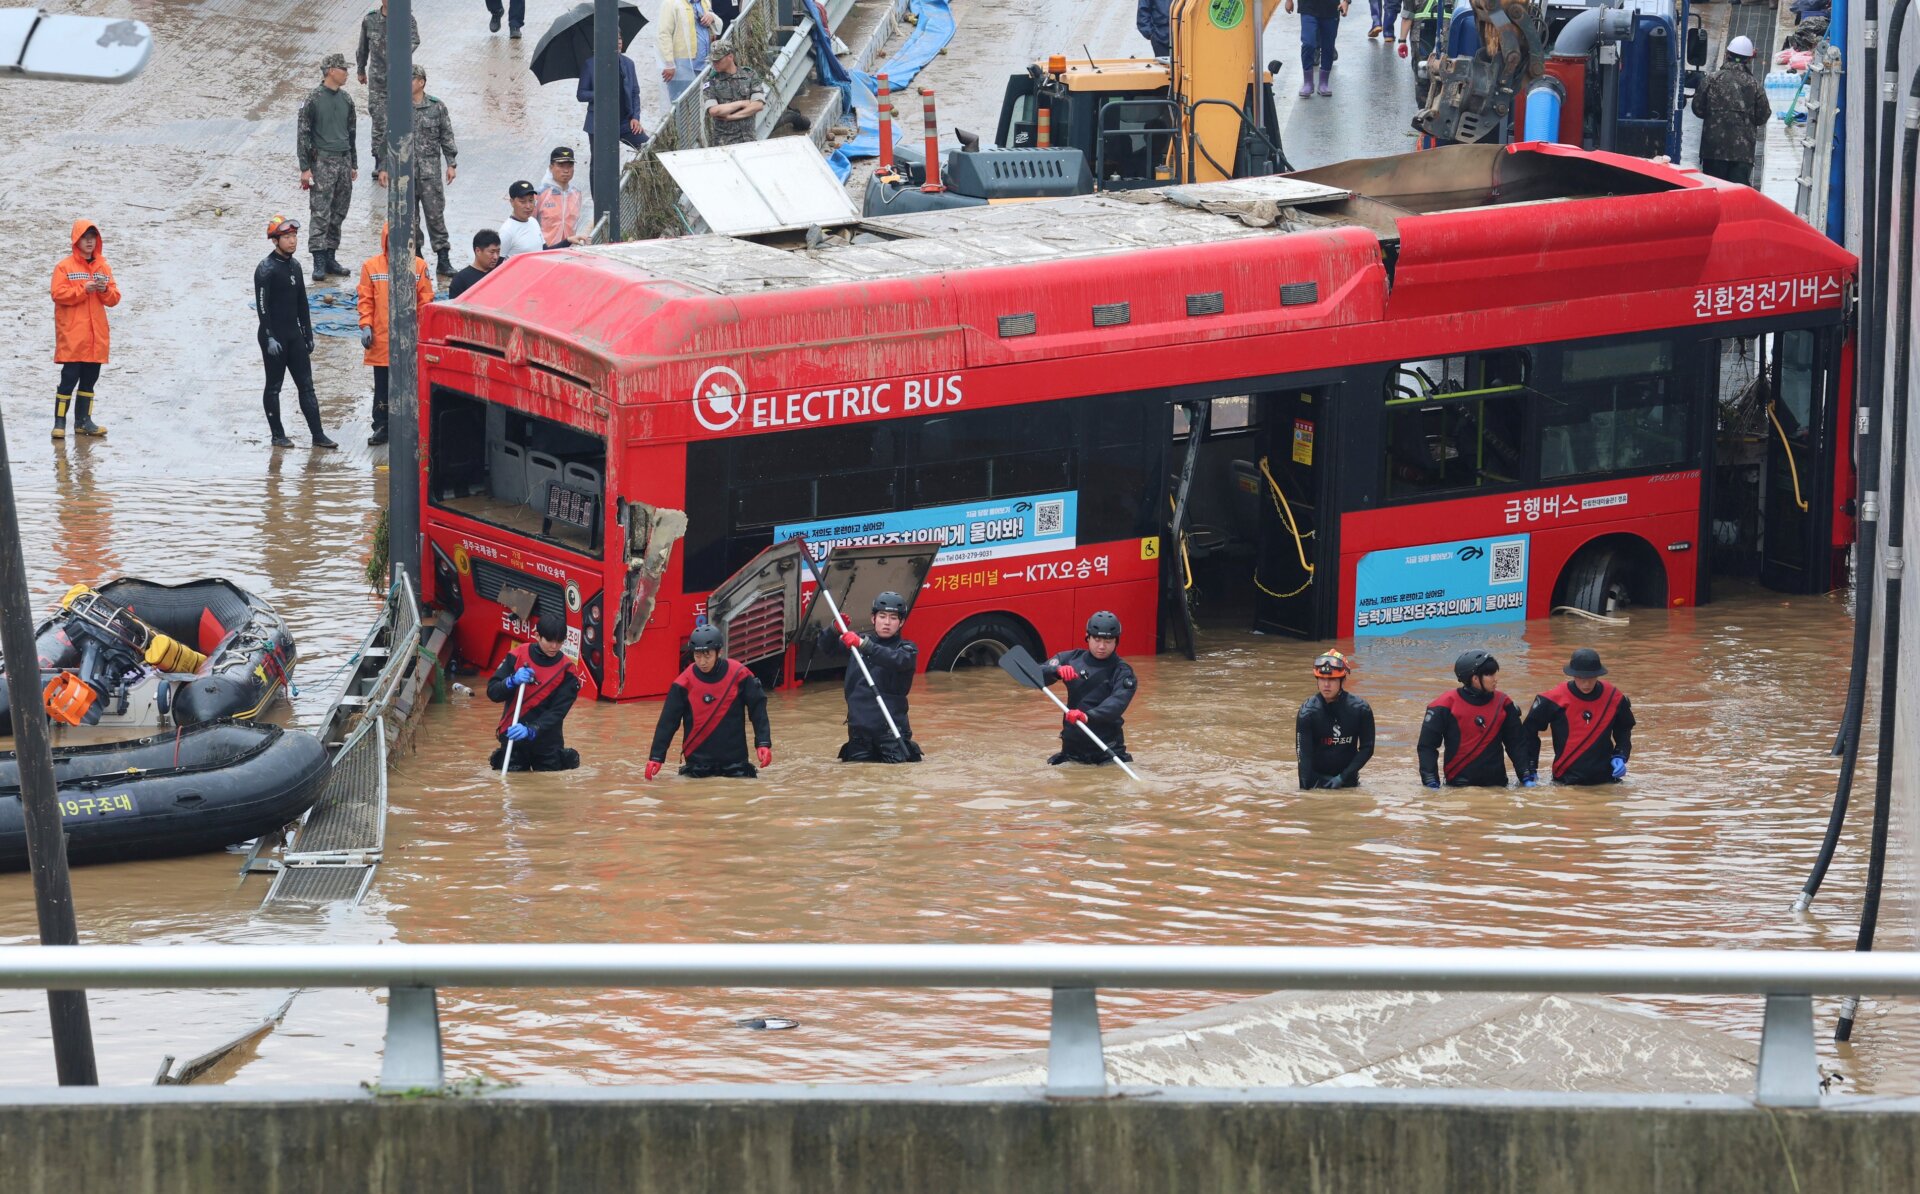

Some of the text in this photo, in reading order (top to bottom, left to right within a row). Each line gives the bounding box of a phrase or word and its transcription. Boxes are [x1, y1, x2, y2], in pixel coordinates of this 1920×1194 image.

[1693, 275, 1841, 318] 친환경전기버스
[752, 374, 964, 429] ELECTRIC BUS
[1503, 494, 1580, 524] 급행버스
[970, 517, 1024, 543] 물어봐!
[946, 554, 955, 562] Tel
[955, 549, 993, 561] 043-279-9031
[536, 562, 566, 581] KTX오송역
[934, 555, 1109, 592] 가경터미널 KTX오송역
[1357, 591, 1524, 627] 능력개발전담주치의에게 물어봐!
[58, 793, 132, 817] 19구조대
